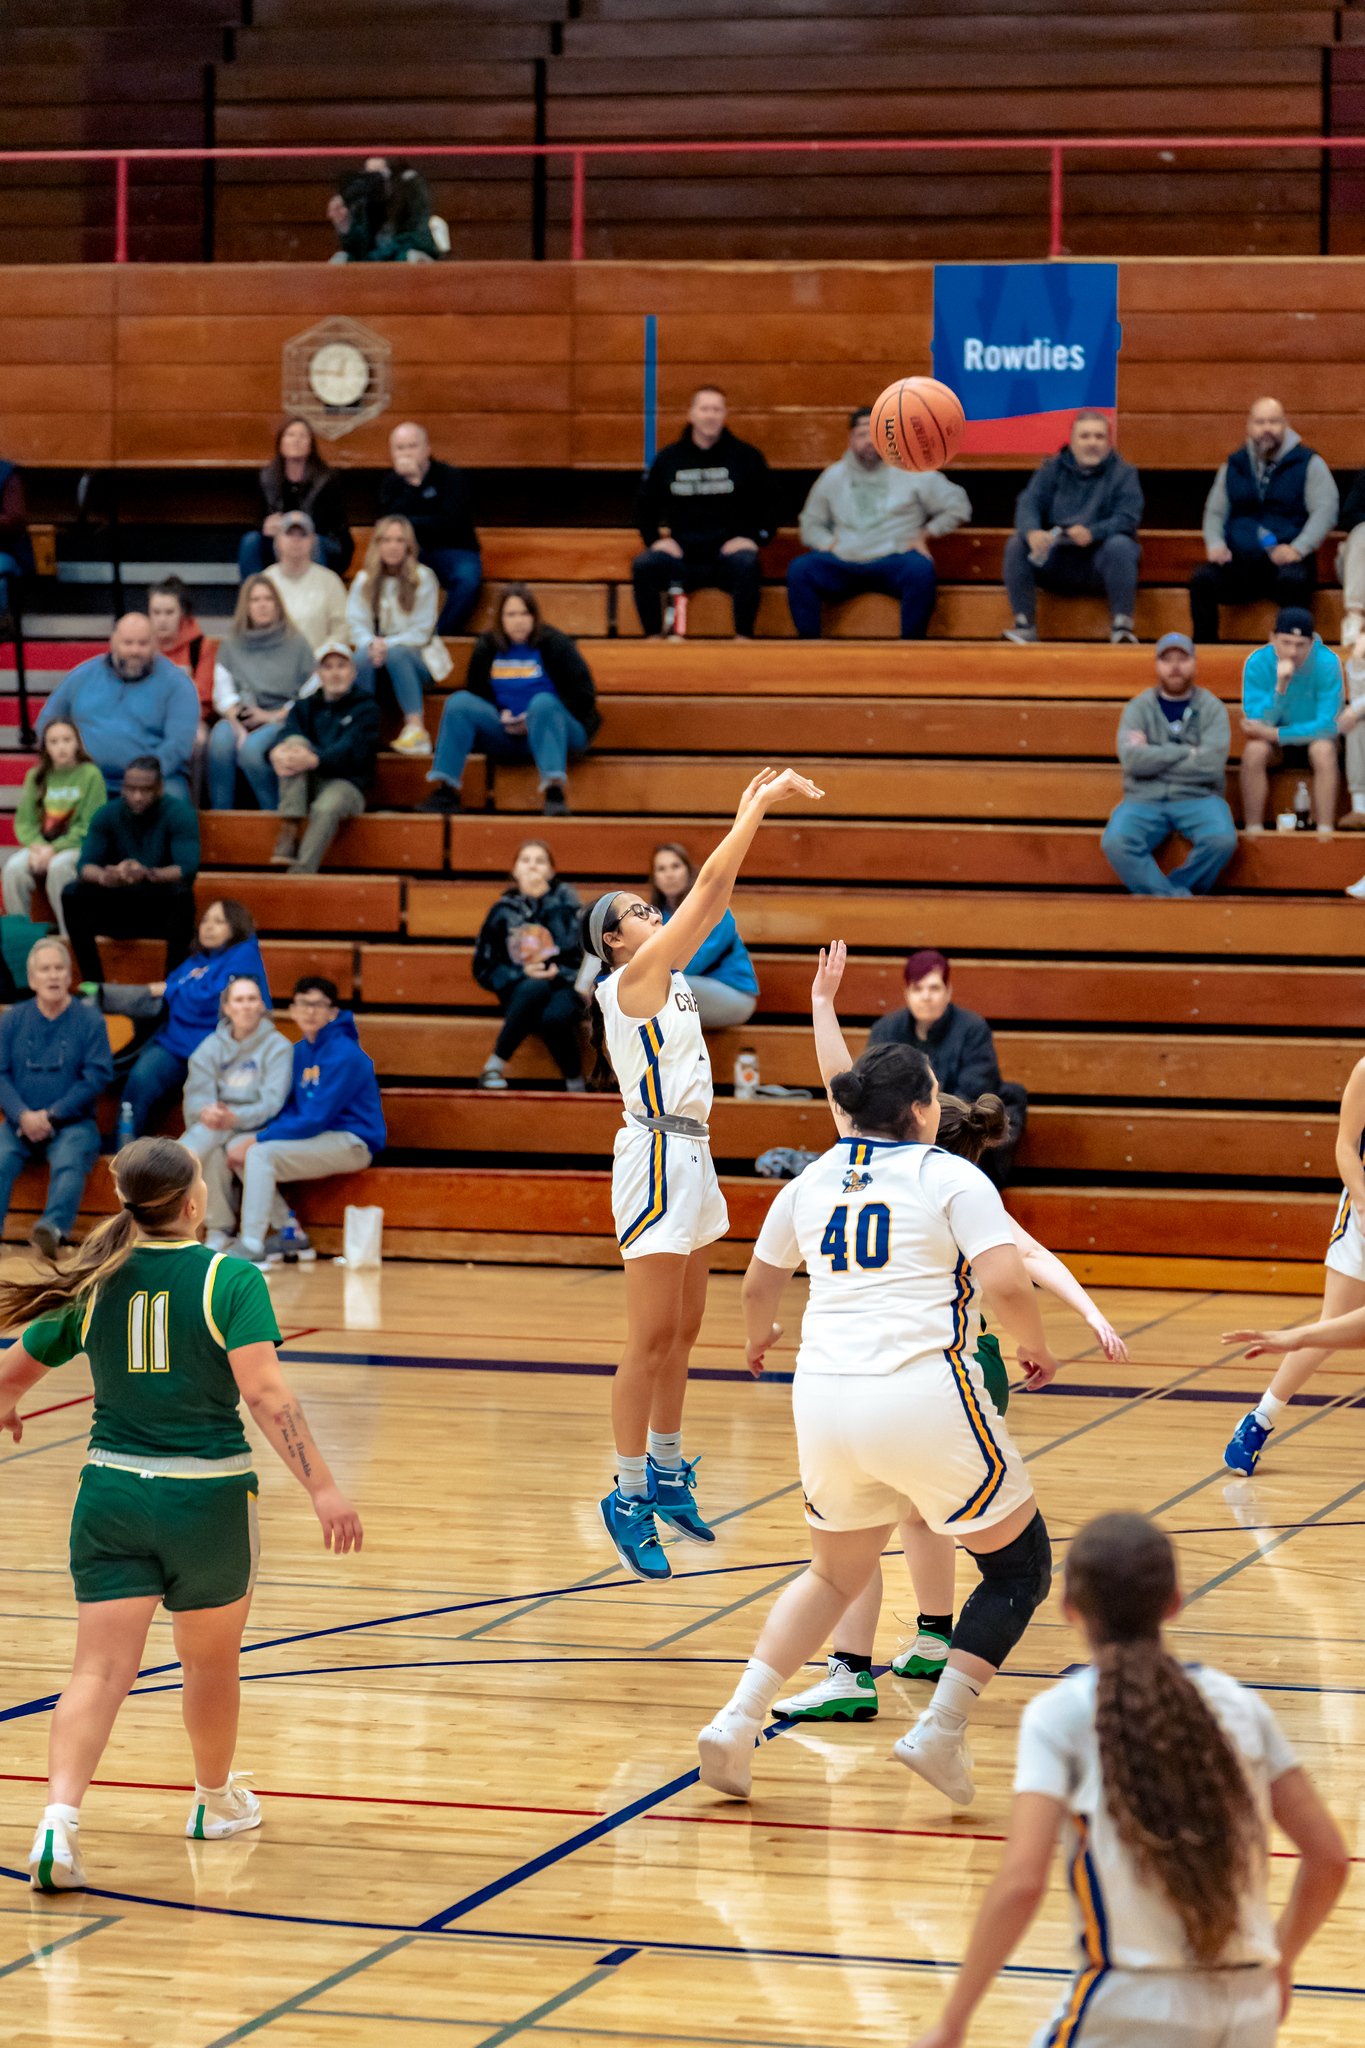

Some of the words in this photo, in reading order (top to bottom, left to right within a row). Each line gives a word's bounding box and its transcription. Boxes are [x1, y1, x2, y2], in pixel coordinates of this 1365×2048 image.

[964, 337, 1086, 371] Rowdies
[820, 1202, 892, 1273] 40
[127, 1290, 170, 1373] 11
